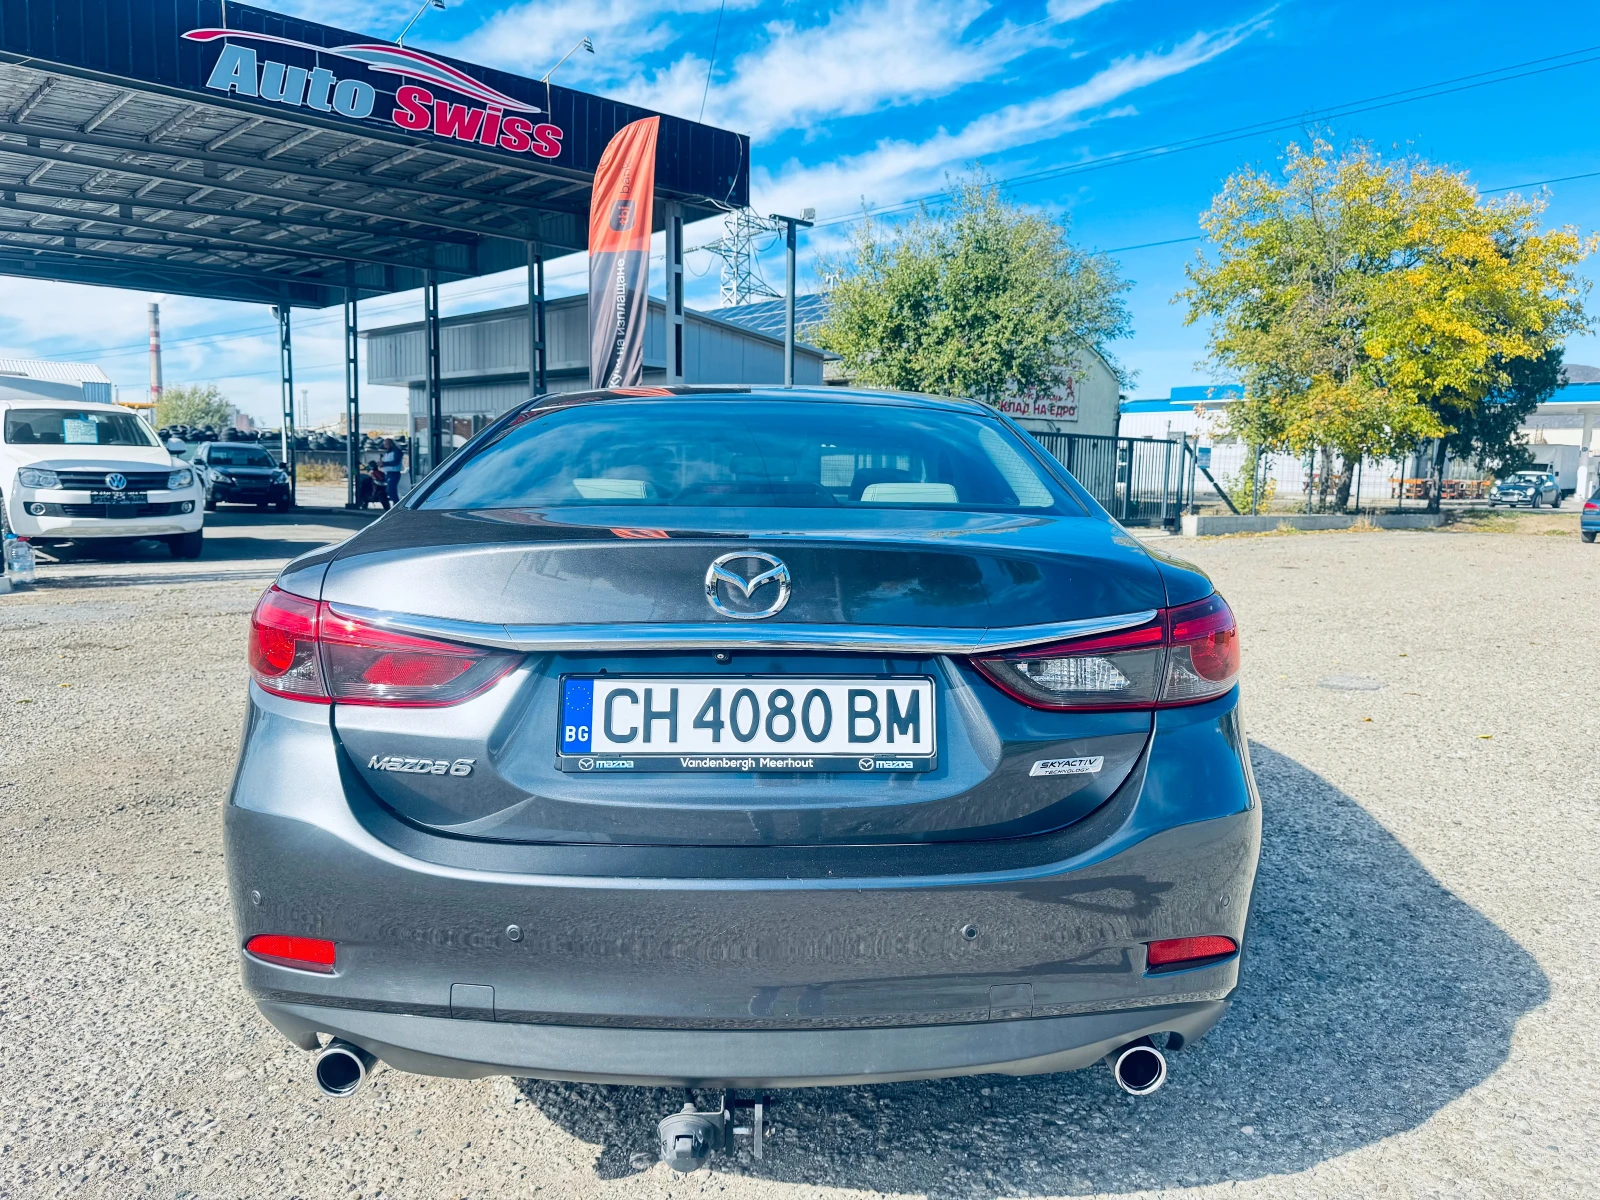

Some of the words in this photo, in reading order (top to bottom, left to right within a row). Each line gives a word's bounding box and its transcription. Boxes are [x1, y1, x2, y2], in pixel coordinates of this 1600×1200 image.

[205, 43, 376, 119] Auto
[392, 85, 563, 158] Swiss
[619, 158, 632, 194] bank
[615, 258, 626, 335] изплащане
[998, 400, 1030, 415] КЛАД
[1033, 404, 1047, 415] НА
[1050, 405, 1076, 418] ЕДРО
[603, 687, 679, 744] CH
[692, 687, 833, 744] 4080
[846, 688, 921, 744] BM
[564, 725, 590, 743] BG
[680, 757, 756, 771] Vandenbergh
[759, 757, 814, 768] Meerhout
[1040, 758, 1097, 769] SKYACTIV
[1044, 767, 1090, 775] TECHNOLOGY
